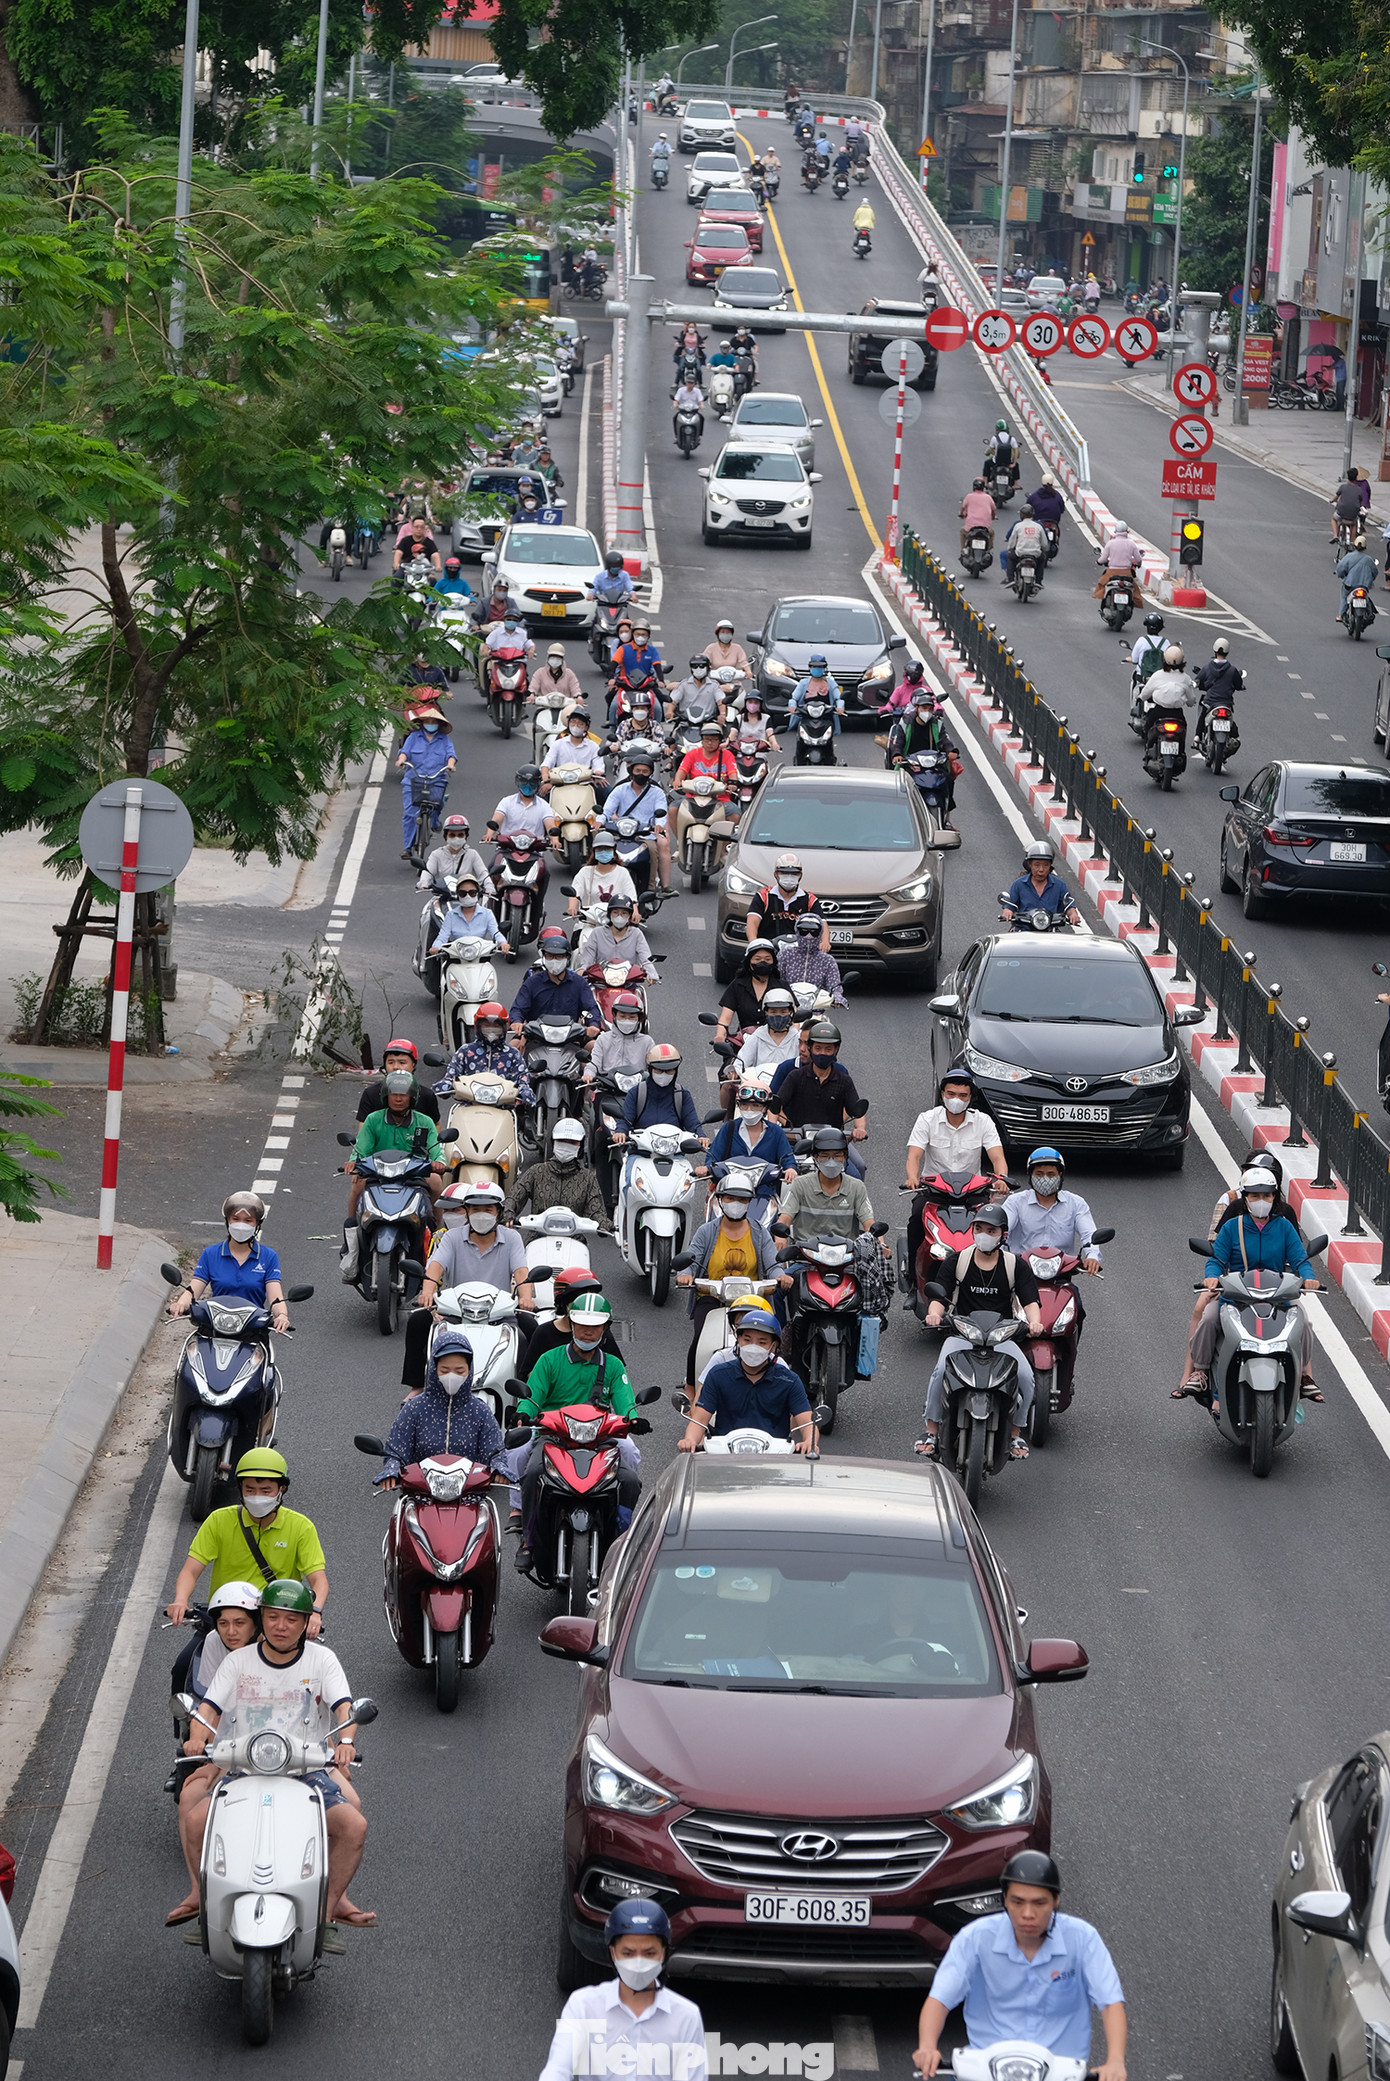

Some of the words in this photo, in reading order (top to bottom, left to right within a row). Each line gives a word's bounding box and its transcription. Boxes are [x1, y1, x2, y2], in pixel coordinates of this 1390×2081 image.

[1163, 165, 1178, 178] 27
[1033, 325, 1053, 344] 30
[1177, 462, 1203, 479] CẤM
[543, 510, 557, 524] G7
[831, 931, 852, 942] 2.96
[1043, 1106, 1108, 1121] 30G-486.55
[749, 1897, 867, 1922] 30F-608.35
